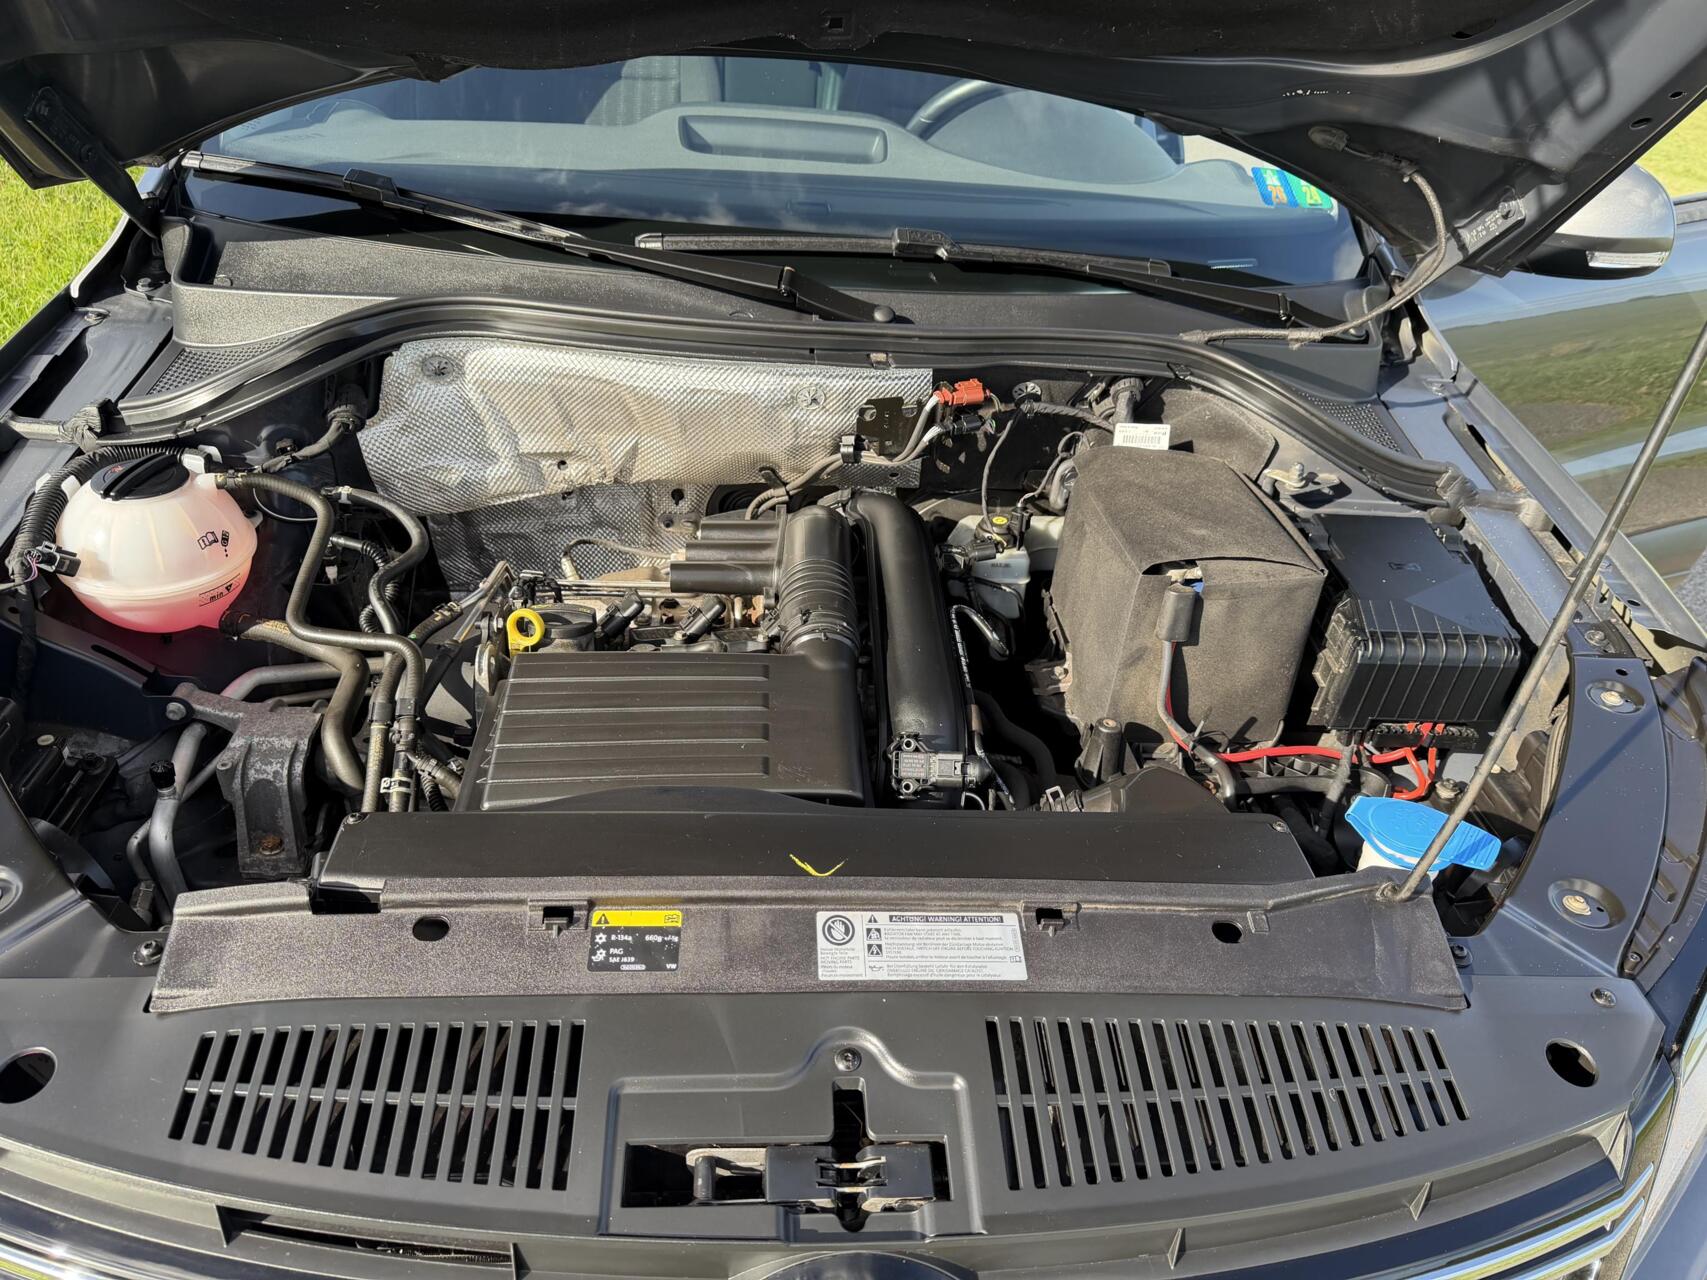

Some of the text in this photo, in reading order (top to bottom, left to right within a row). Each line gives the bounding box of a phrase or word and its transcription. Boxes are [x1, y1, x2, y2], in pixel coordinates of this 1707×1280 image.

[209, 592, 224, 602] min
[927, 915, 962, 923] WARNING!
[645, 934, 662, 943] 660g
